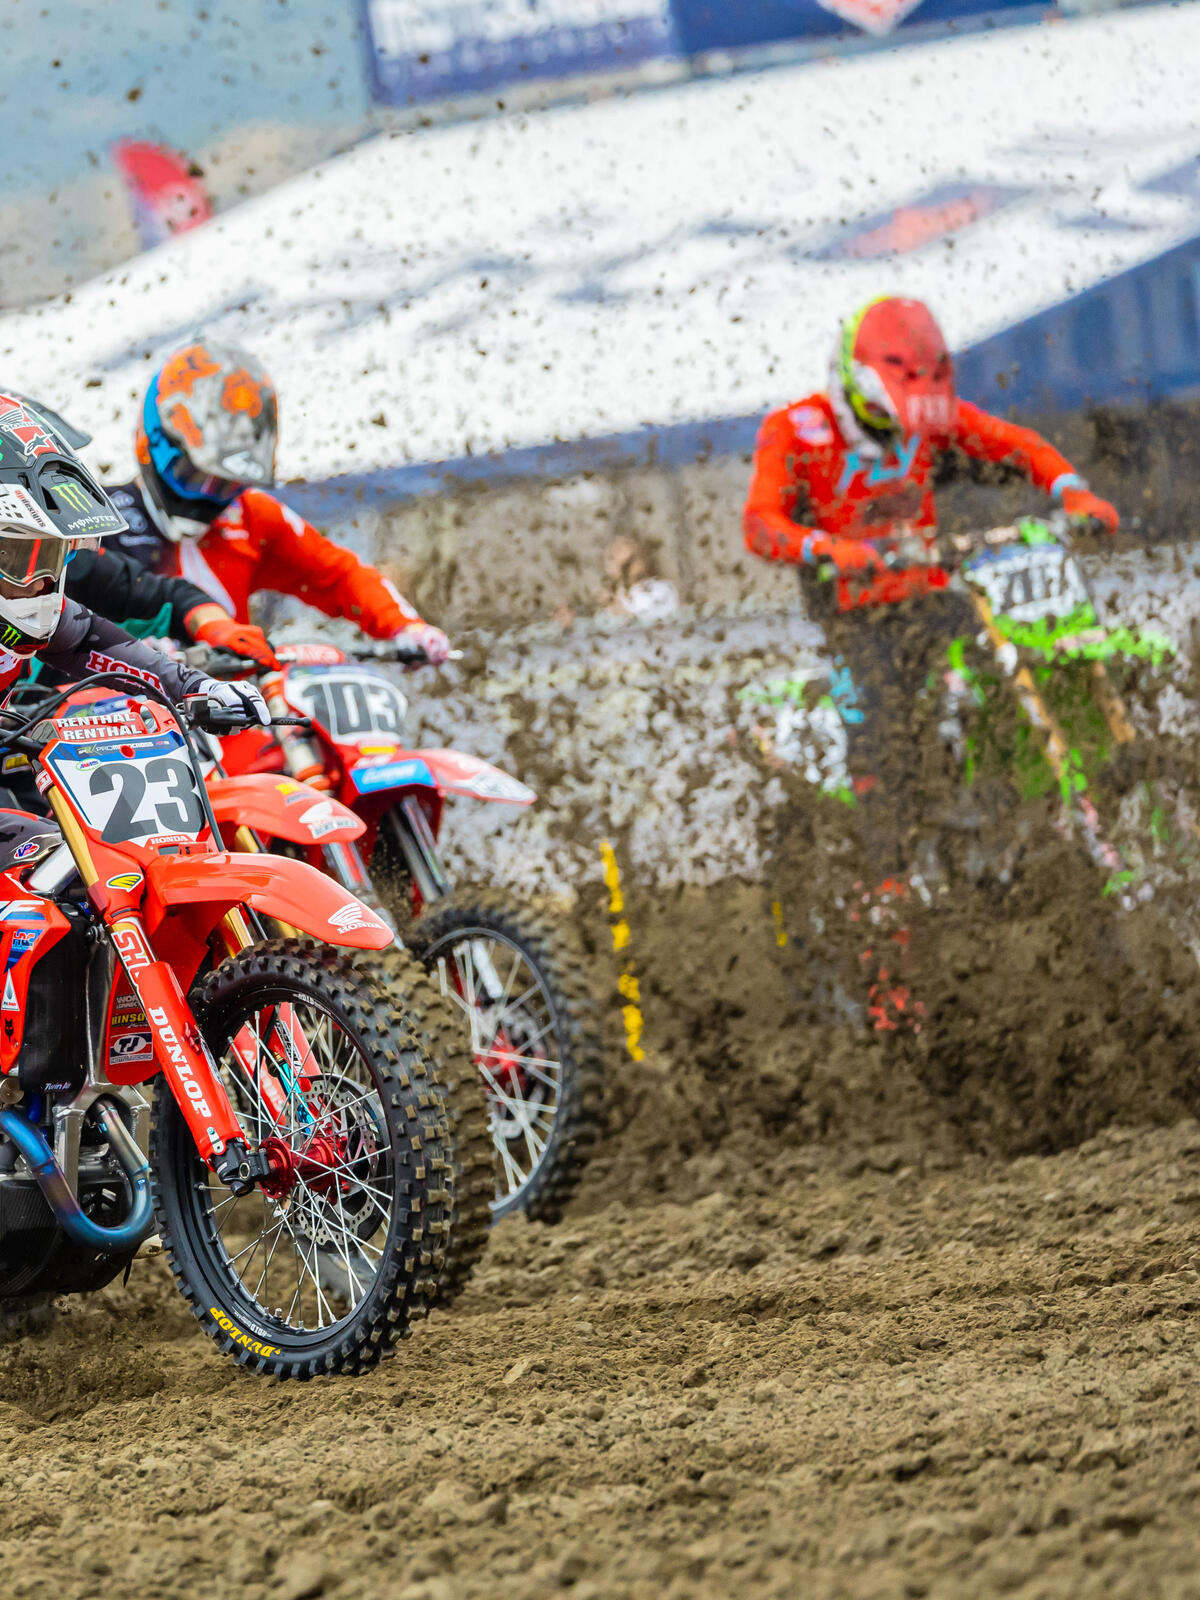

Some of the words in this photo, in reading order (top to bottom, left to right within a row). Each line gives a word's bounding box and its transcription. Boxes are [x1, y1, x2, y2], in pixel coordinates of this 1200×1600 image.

[302, 682, 401, 735] 103
[56, 713, 136, 728] RENTHAL
[63, 725, 143, 740] RENTHAL
[89, 758, 205, 844] 23
[151, 835, 190, 844] HONDA
[337, 919, 383, 934] HONDA
[148, 1006, 213, 1119] DUNLOP
[44, 1082, 62, 1092] Twin
[209, 1307, 277, 1357] DUNLOP
